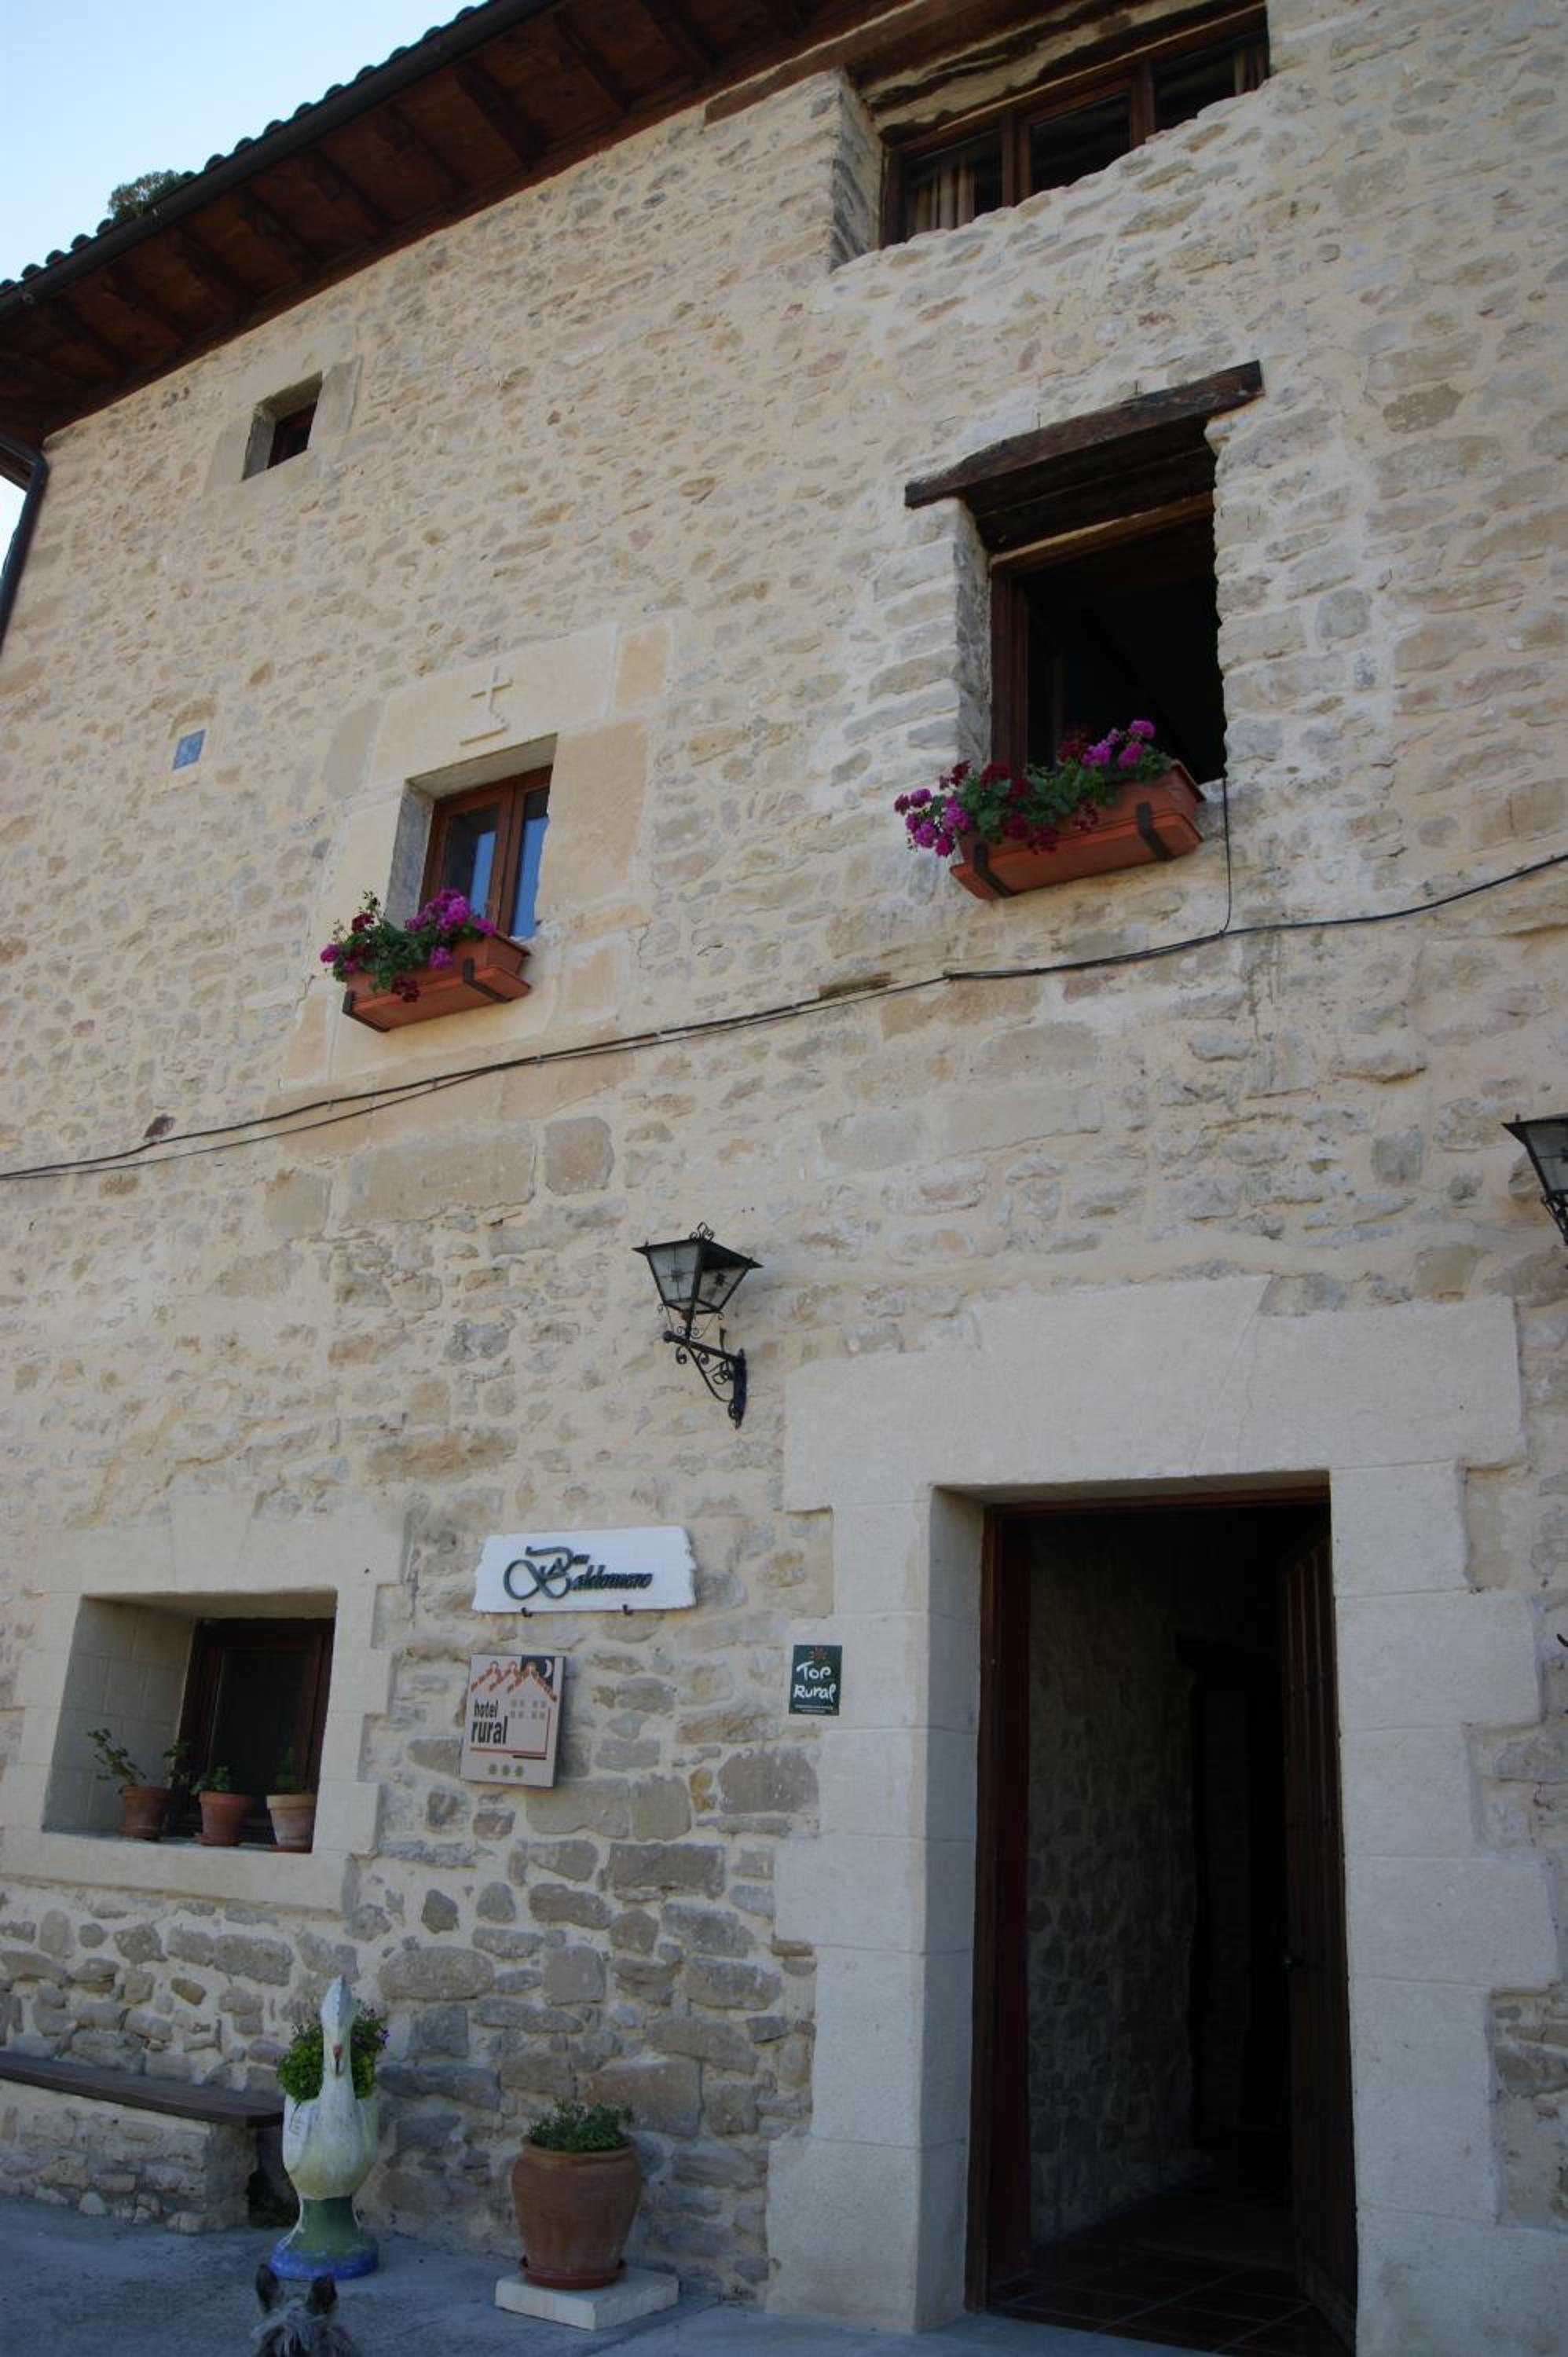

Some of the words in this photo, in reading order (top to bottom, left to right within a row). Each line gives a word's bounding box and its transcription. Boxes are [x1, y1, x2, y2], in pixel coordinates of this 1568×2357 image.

[793, 1683, 836, 1703] Rural
[474, 1699, 498, 1718] hotel
[471, 1716, 507, 1744] rural
